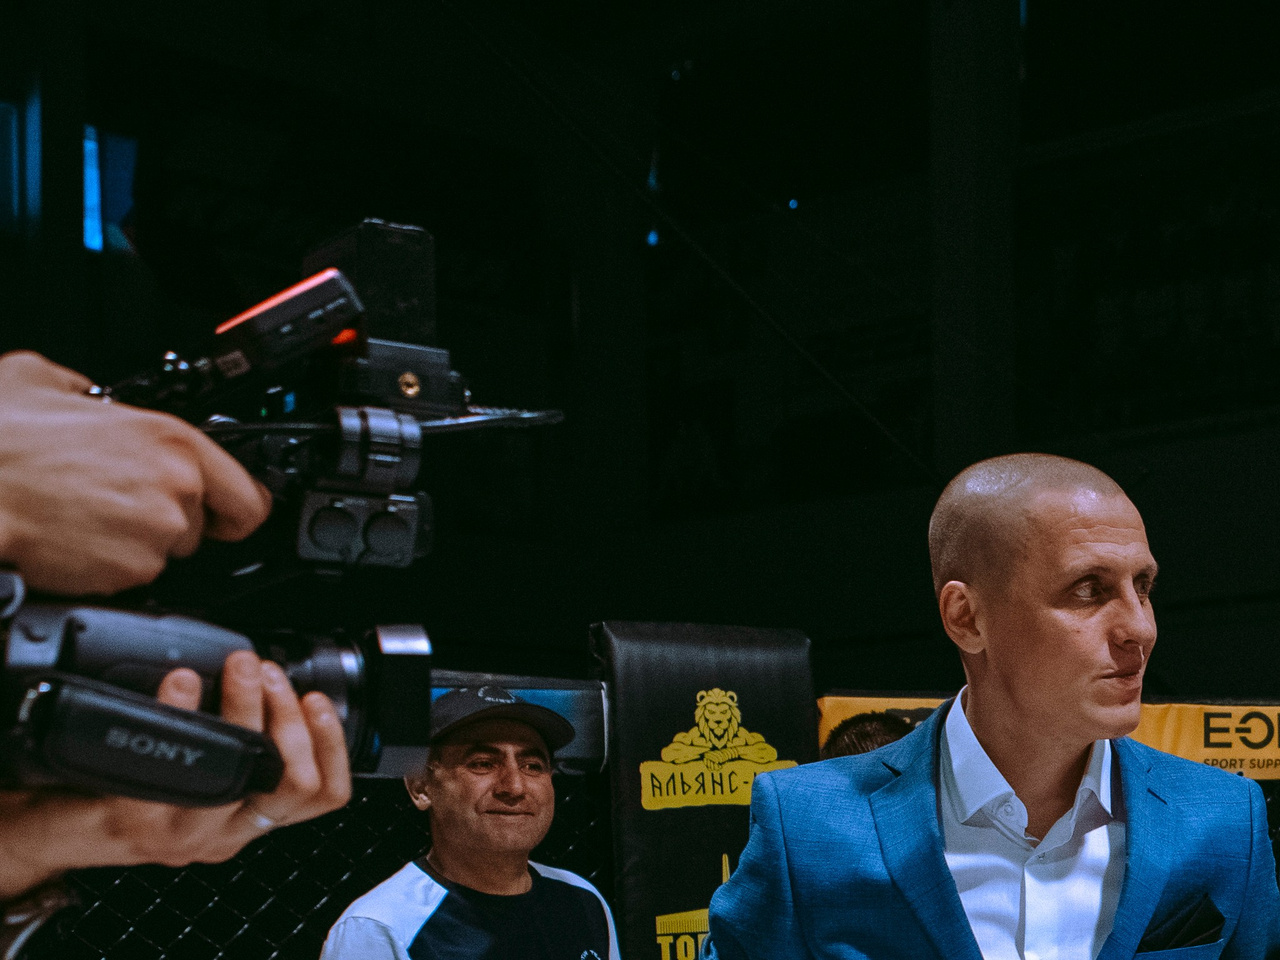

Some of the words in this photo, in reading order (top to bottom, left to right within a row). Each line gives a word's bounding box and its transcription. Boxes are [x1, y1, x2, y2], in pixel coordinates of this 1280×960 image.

[105, 726, 203, 767] SONY
[1203, 758, 1245, 770] SPORT
[650, 772, 758, 798] АЛЬЯНС-
